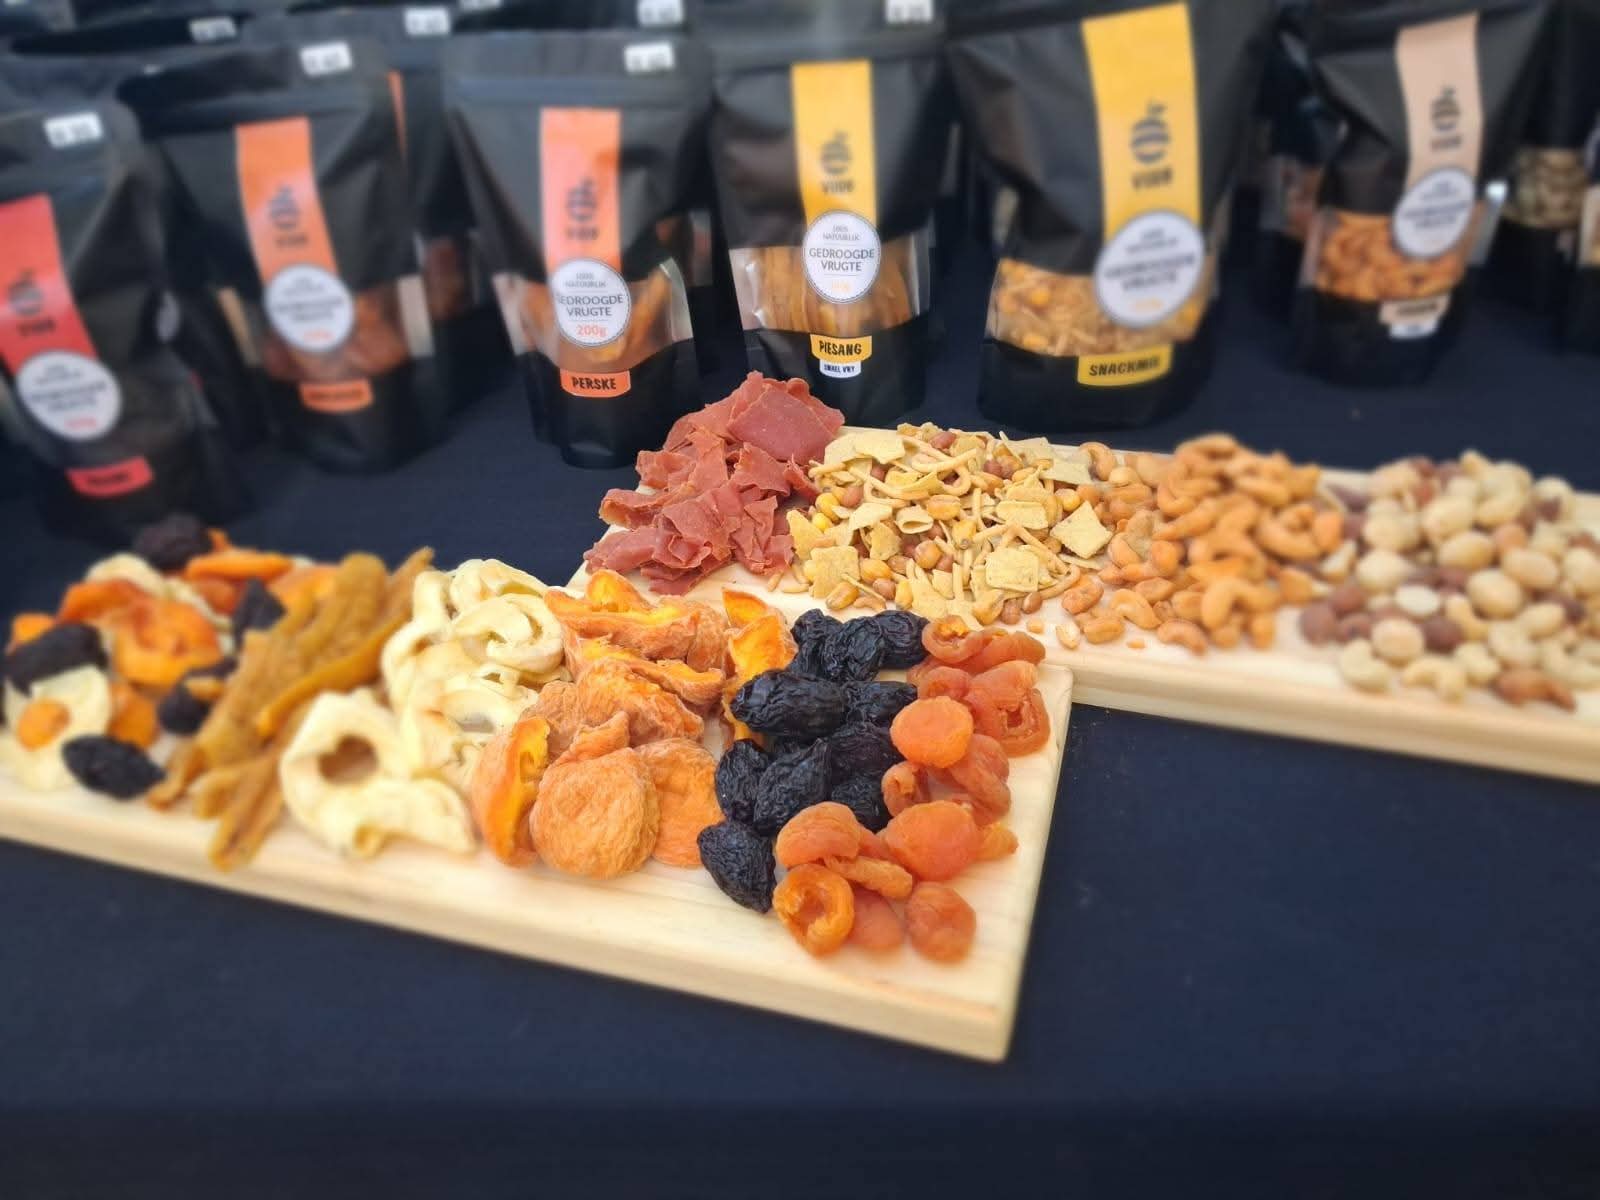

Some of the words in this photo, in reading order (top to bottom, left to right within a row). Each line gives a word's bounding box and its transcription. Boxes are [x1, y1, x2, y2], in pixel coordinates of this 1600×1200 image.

[808, 247, 876, 260] GEDROOGDE
[820, 260, 863, 272] VRUGTE
[565, 306, 613, 317] VRUGTE
[575, 323, 608, 338] 200g
[818, 340, 863, 356] PIESANG
[571, 375, 617, 391] PERSKE
